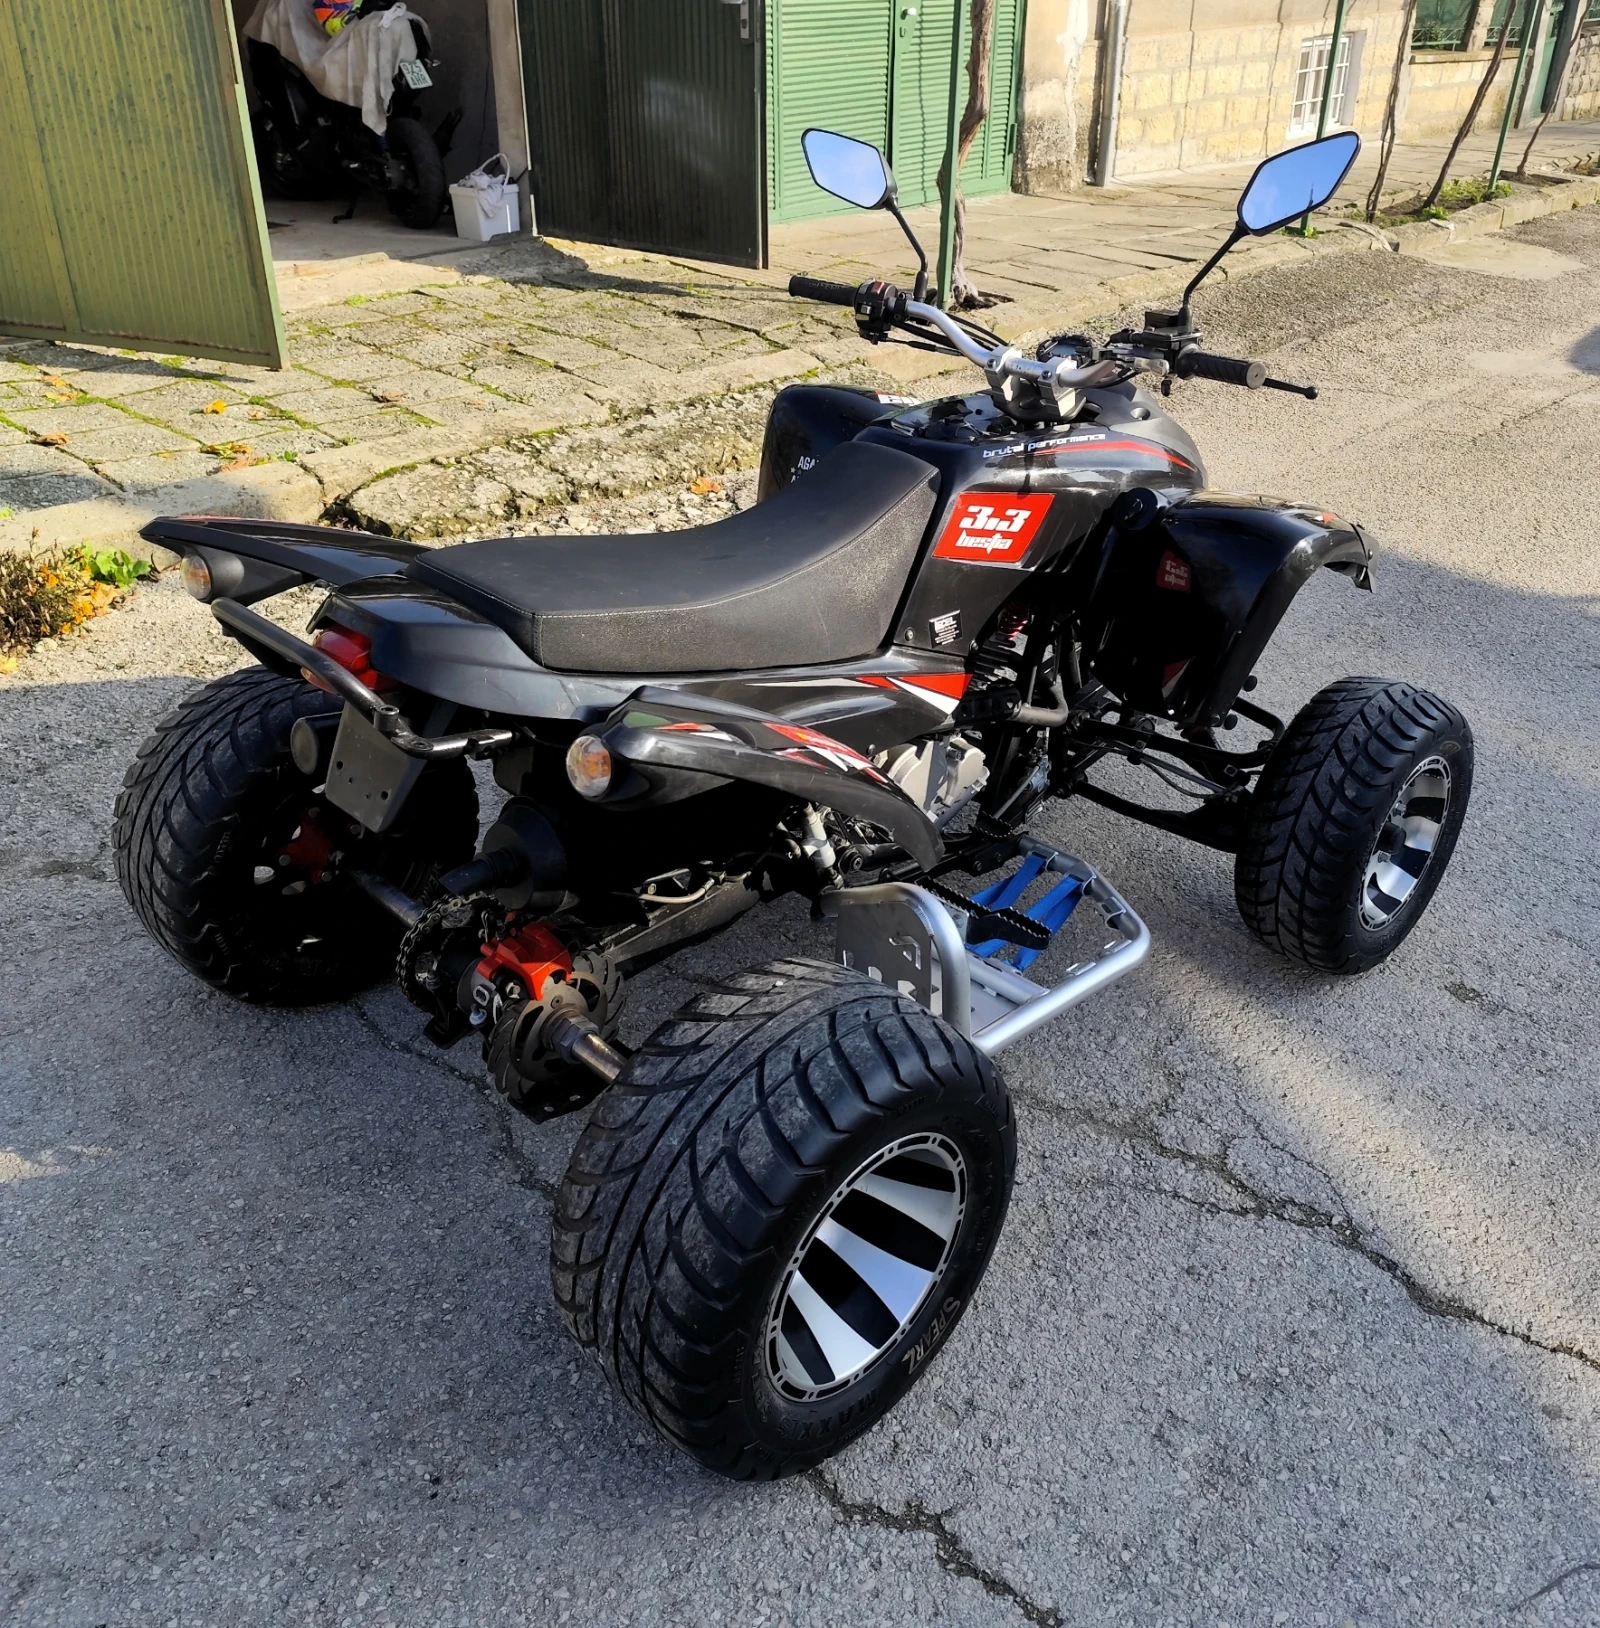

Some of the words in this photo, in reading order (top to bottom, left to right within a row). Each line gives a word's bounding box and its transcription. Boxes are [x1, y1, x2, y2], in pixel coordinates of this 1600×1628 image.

[983, 443, 1024, 458] brutal
[1028, 434, 1106, 450] performance
[959, 505, 1032, 533] 3.3
[778, 1387, 878, 1441] MAXXIS
